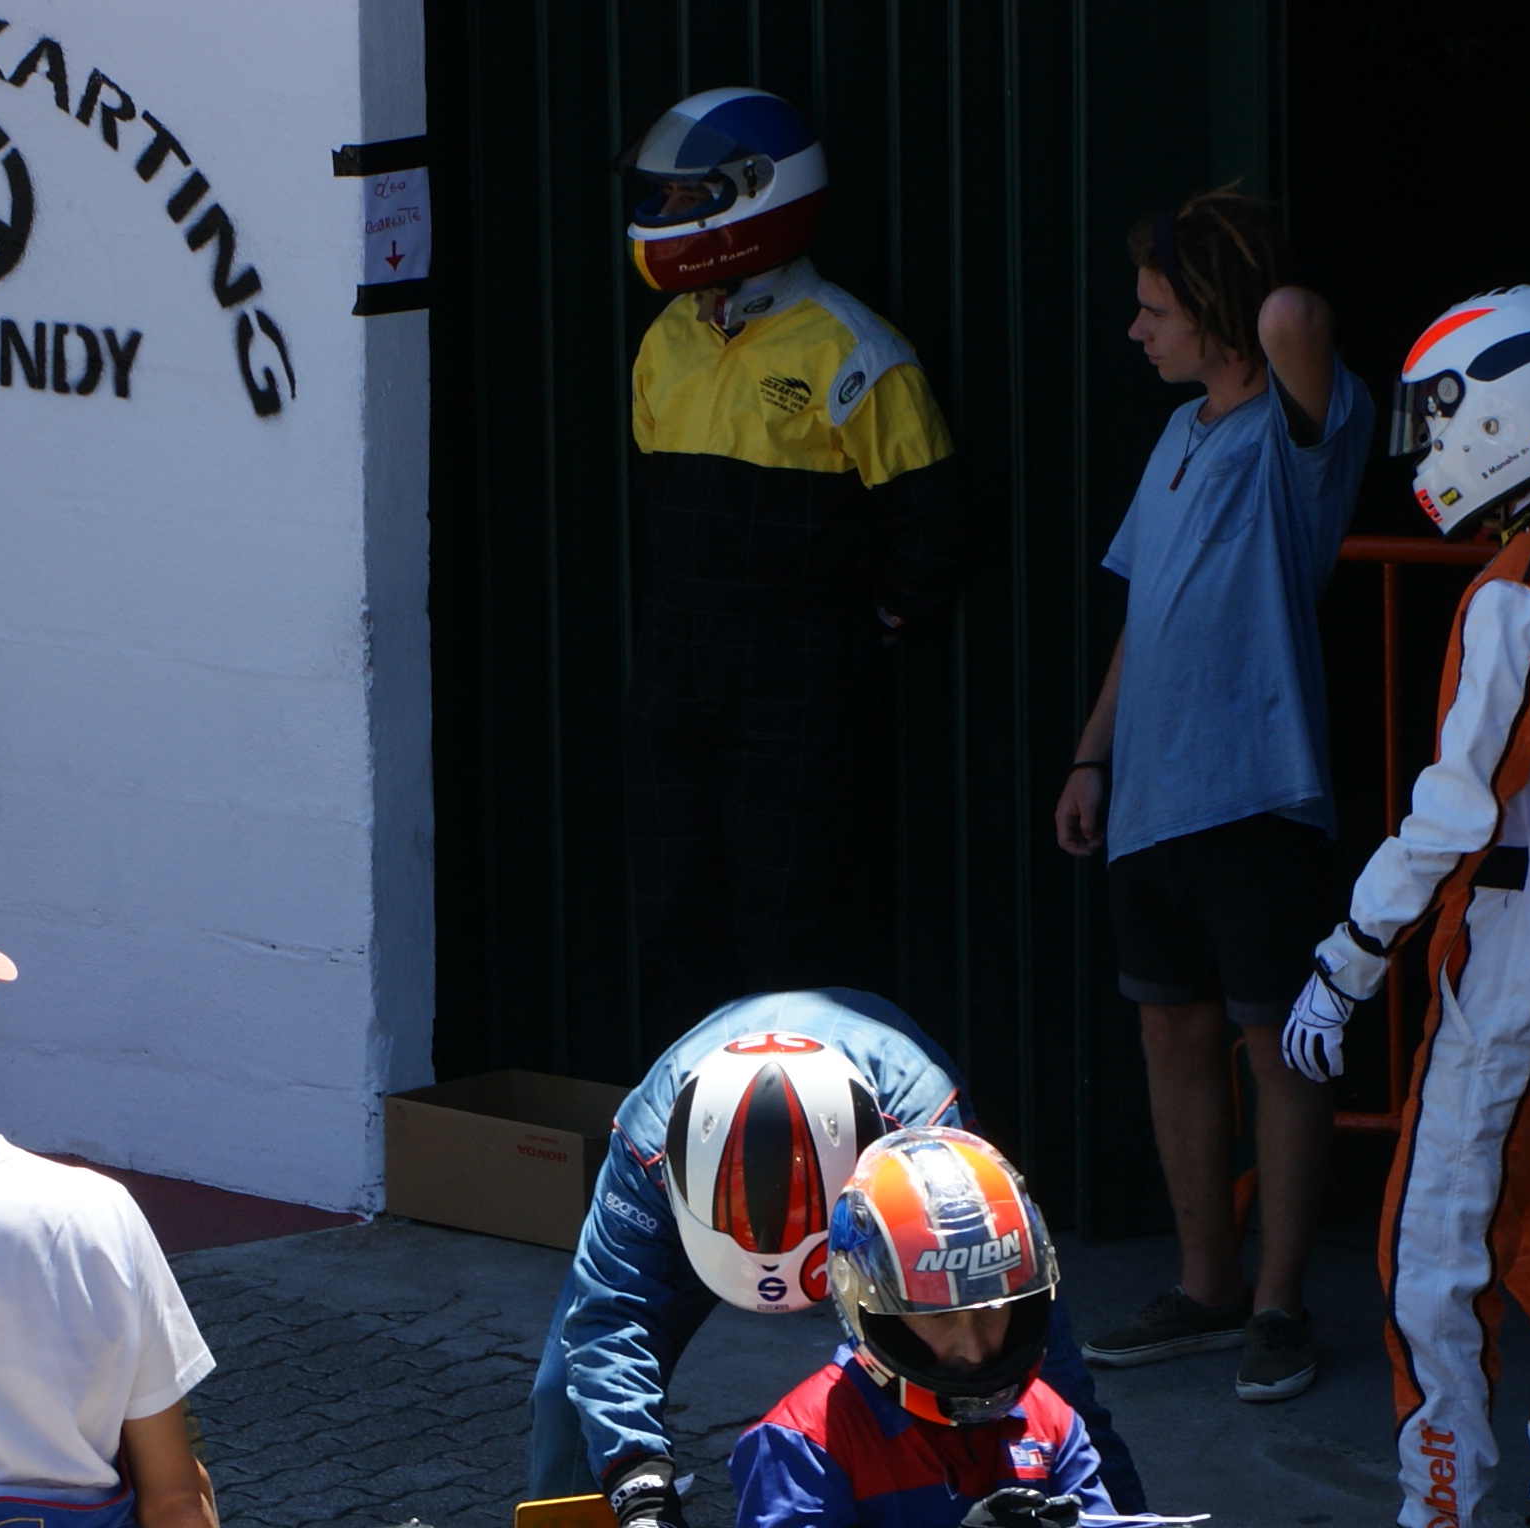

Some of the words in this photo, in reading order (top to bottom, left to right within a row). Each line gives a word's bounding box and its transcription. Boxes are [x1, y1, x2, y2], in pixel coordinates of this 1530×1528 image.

[516, 1144, 568, 1163] HONDA
[605, 1191, 658, 1230] sparco
[915, 1228, 1023, 1281] NOLAN
